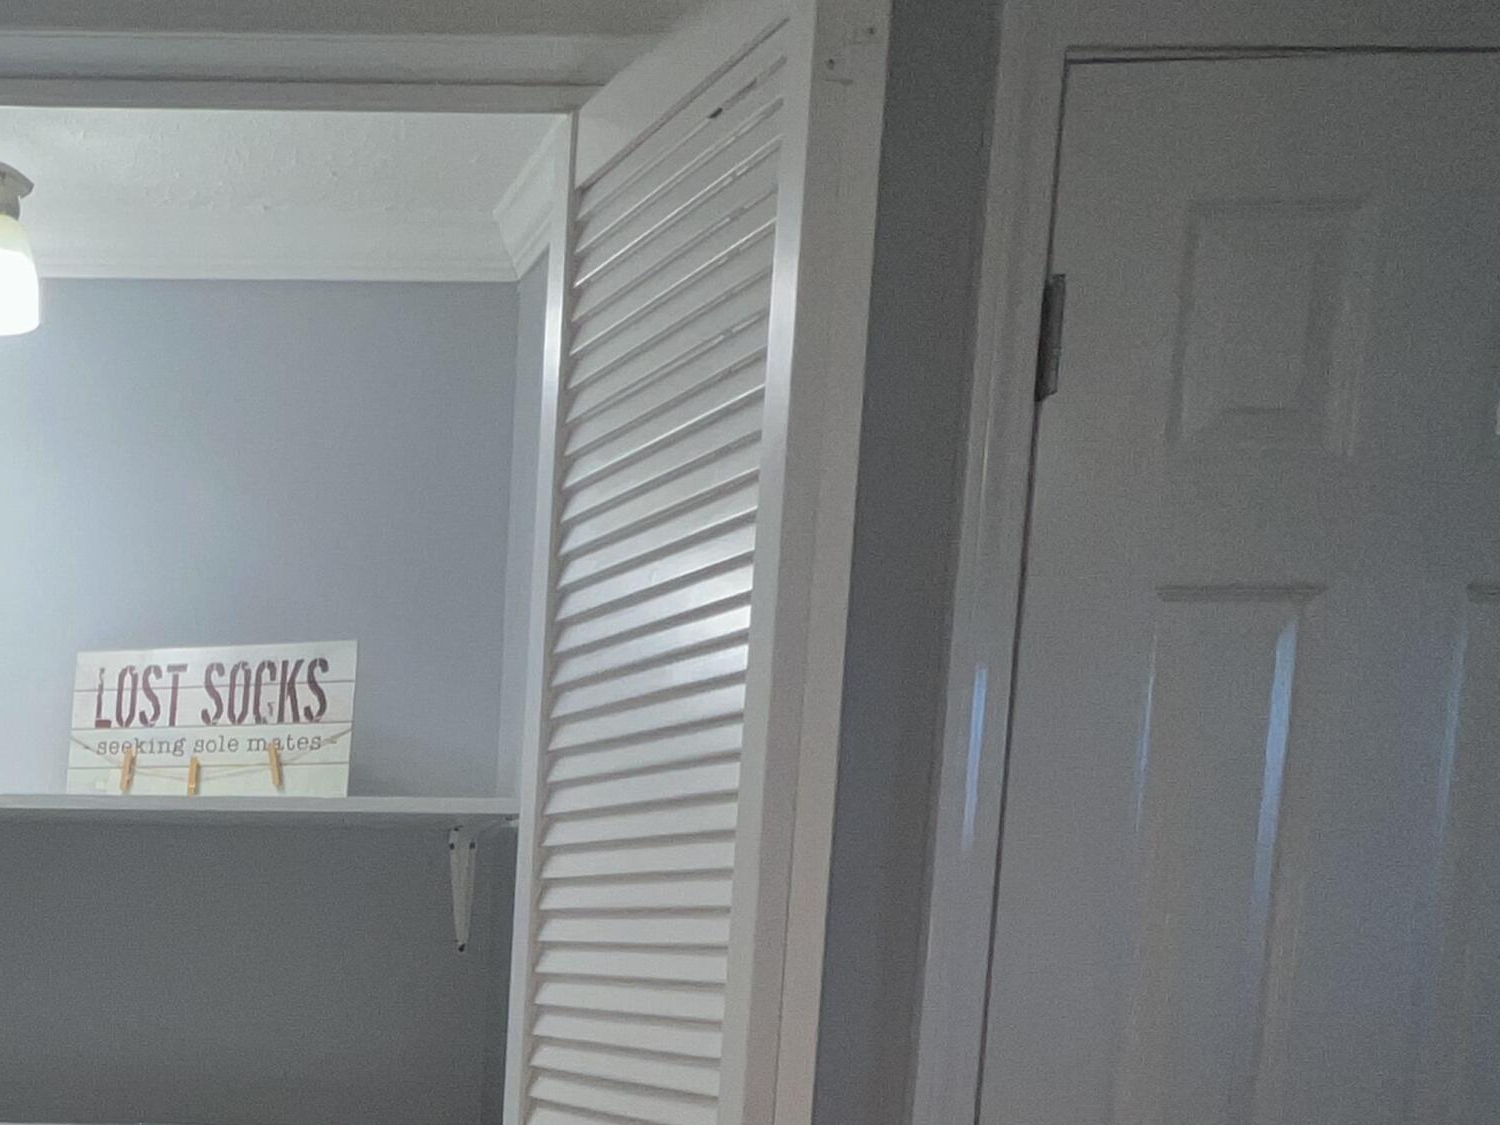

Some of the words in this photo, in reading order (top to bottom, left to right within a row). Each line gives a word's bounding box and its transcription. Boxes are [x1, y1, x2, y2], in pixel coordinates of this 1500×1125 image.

[95, 664, 188, 729] LOST
[201, 657, 330, 726] SOCKS
[96, 737, 187, 757] seeking
[193, 735, 240, 753] sole
[246, 733, 322, 752] mates
